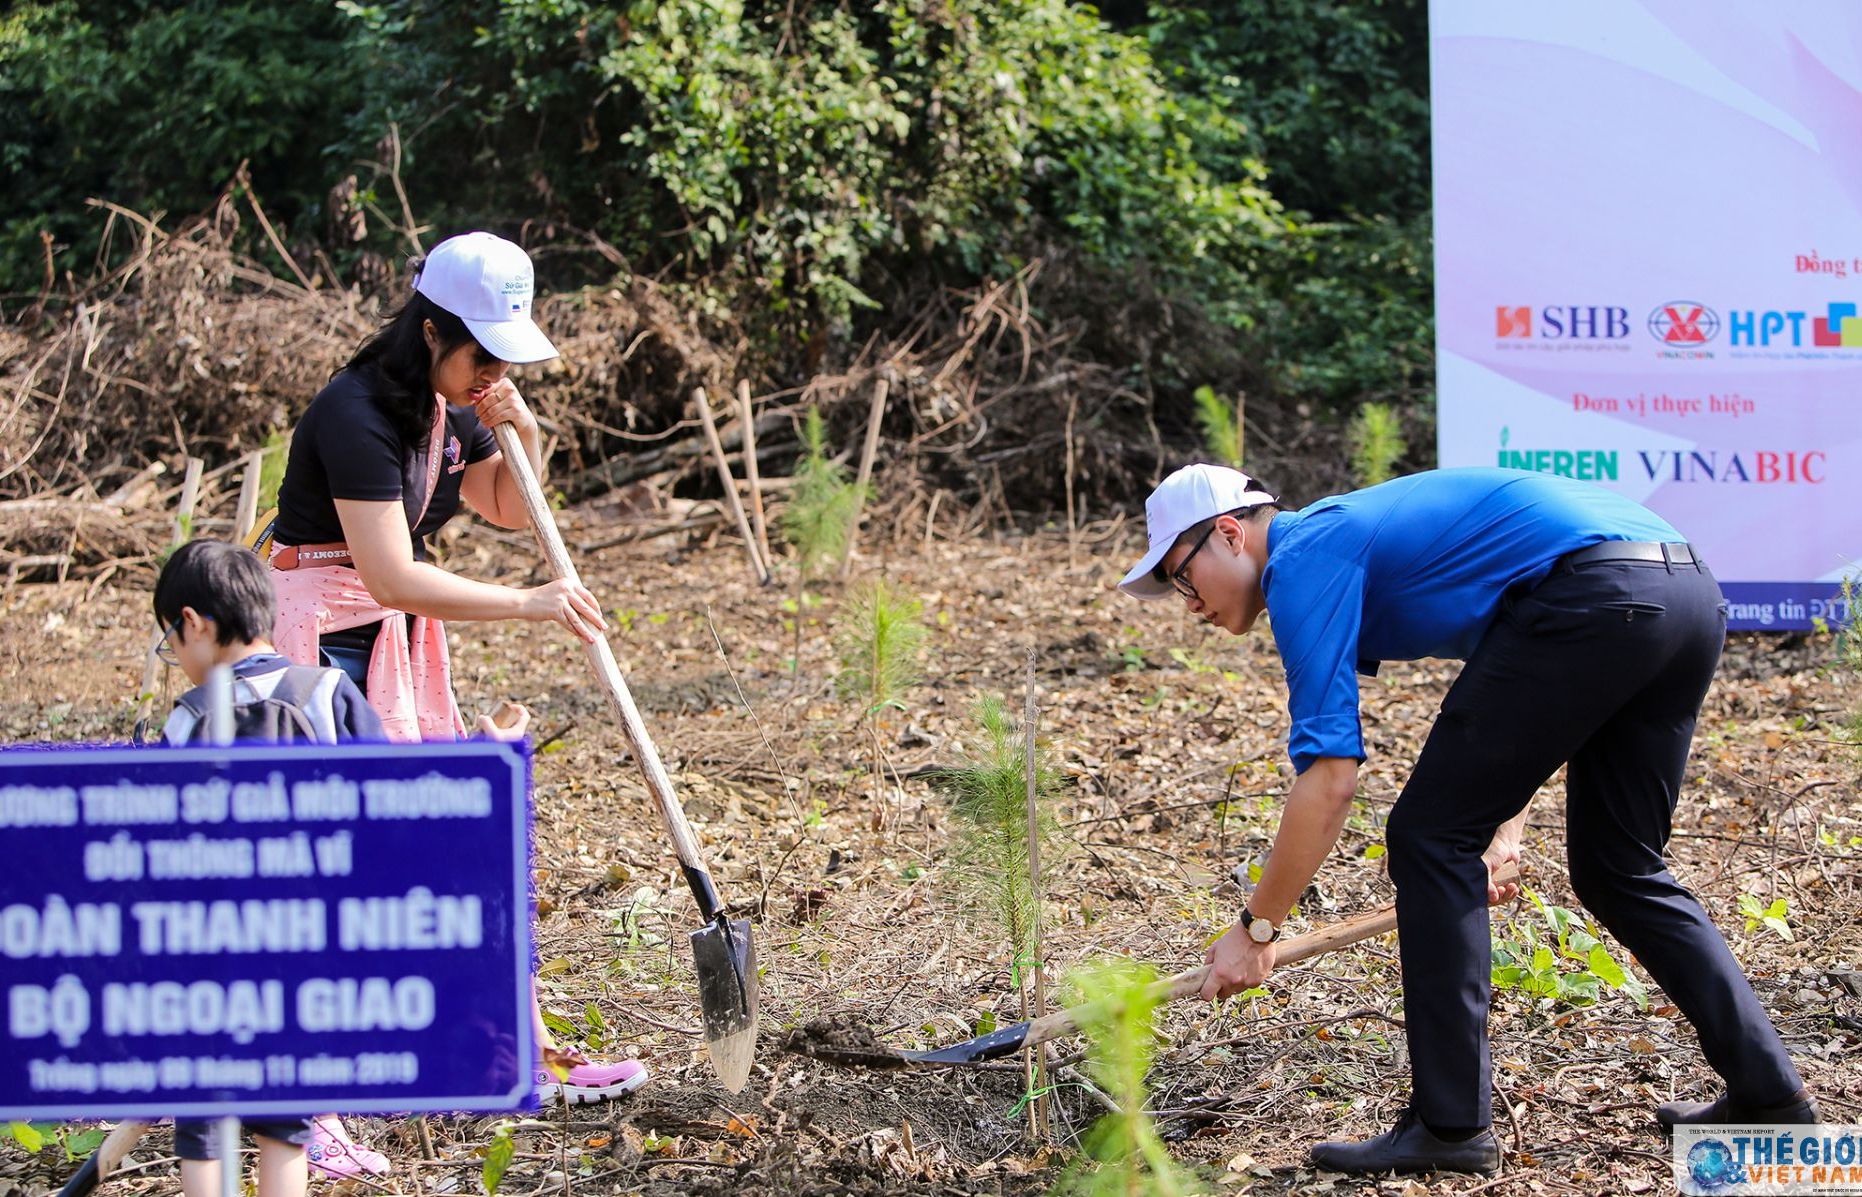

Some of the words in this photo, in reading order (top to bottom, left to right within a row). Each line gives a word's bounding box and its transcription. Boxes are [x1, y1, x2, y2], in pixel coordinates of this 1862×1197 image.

[1795, 248, 1846, 280] Đồng
[1541, 304, 1631, 341] SHB
[1729, 310, 1806, 347] HPT
[1572, 392, 1619, 413] Đơn
[1626, 395, 1646, 417] vị
[1653, 393, 1703, 418] thực
[1708, 392, 1756, 417] hiện
[1638, 450, 1827, 484] VINABIC
[1724, 598, 1775, 625] rang
[1779, 598, 1806, 619] tin
[131, 896, 327, 956] THANH
[337, 885, 483, 952] NIÊN
[8, 973, 92, 1049] BỘ
[102, 978, 285, 1045] NGOẠI
[295, 975, 436, 1033] GIAO
[265, 1053, 296, 1087] 11
